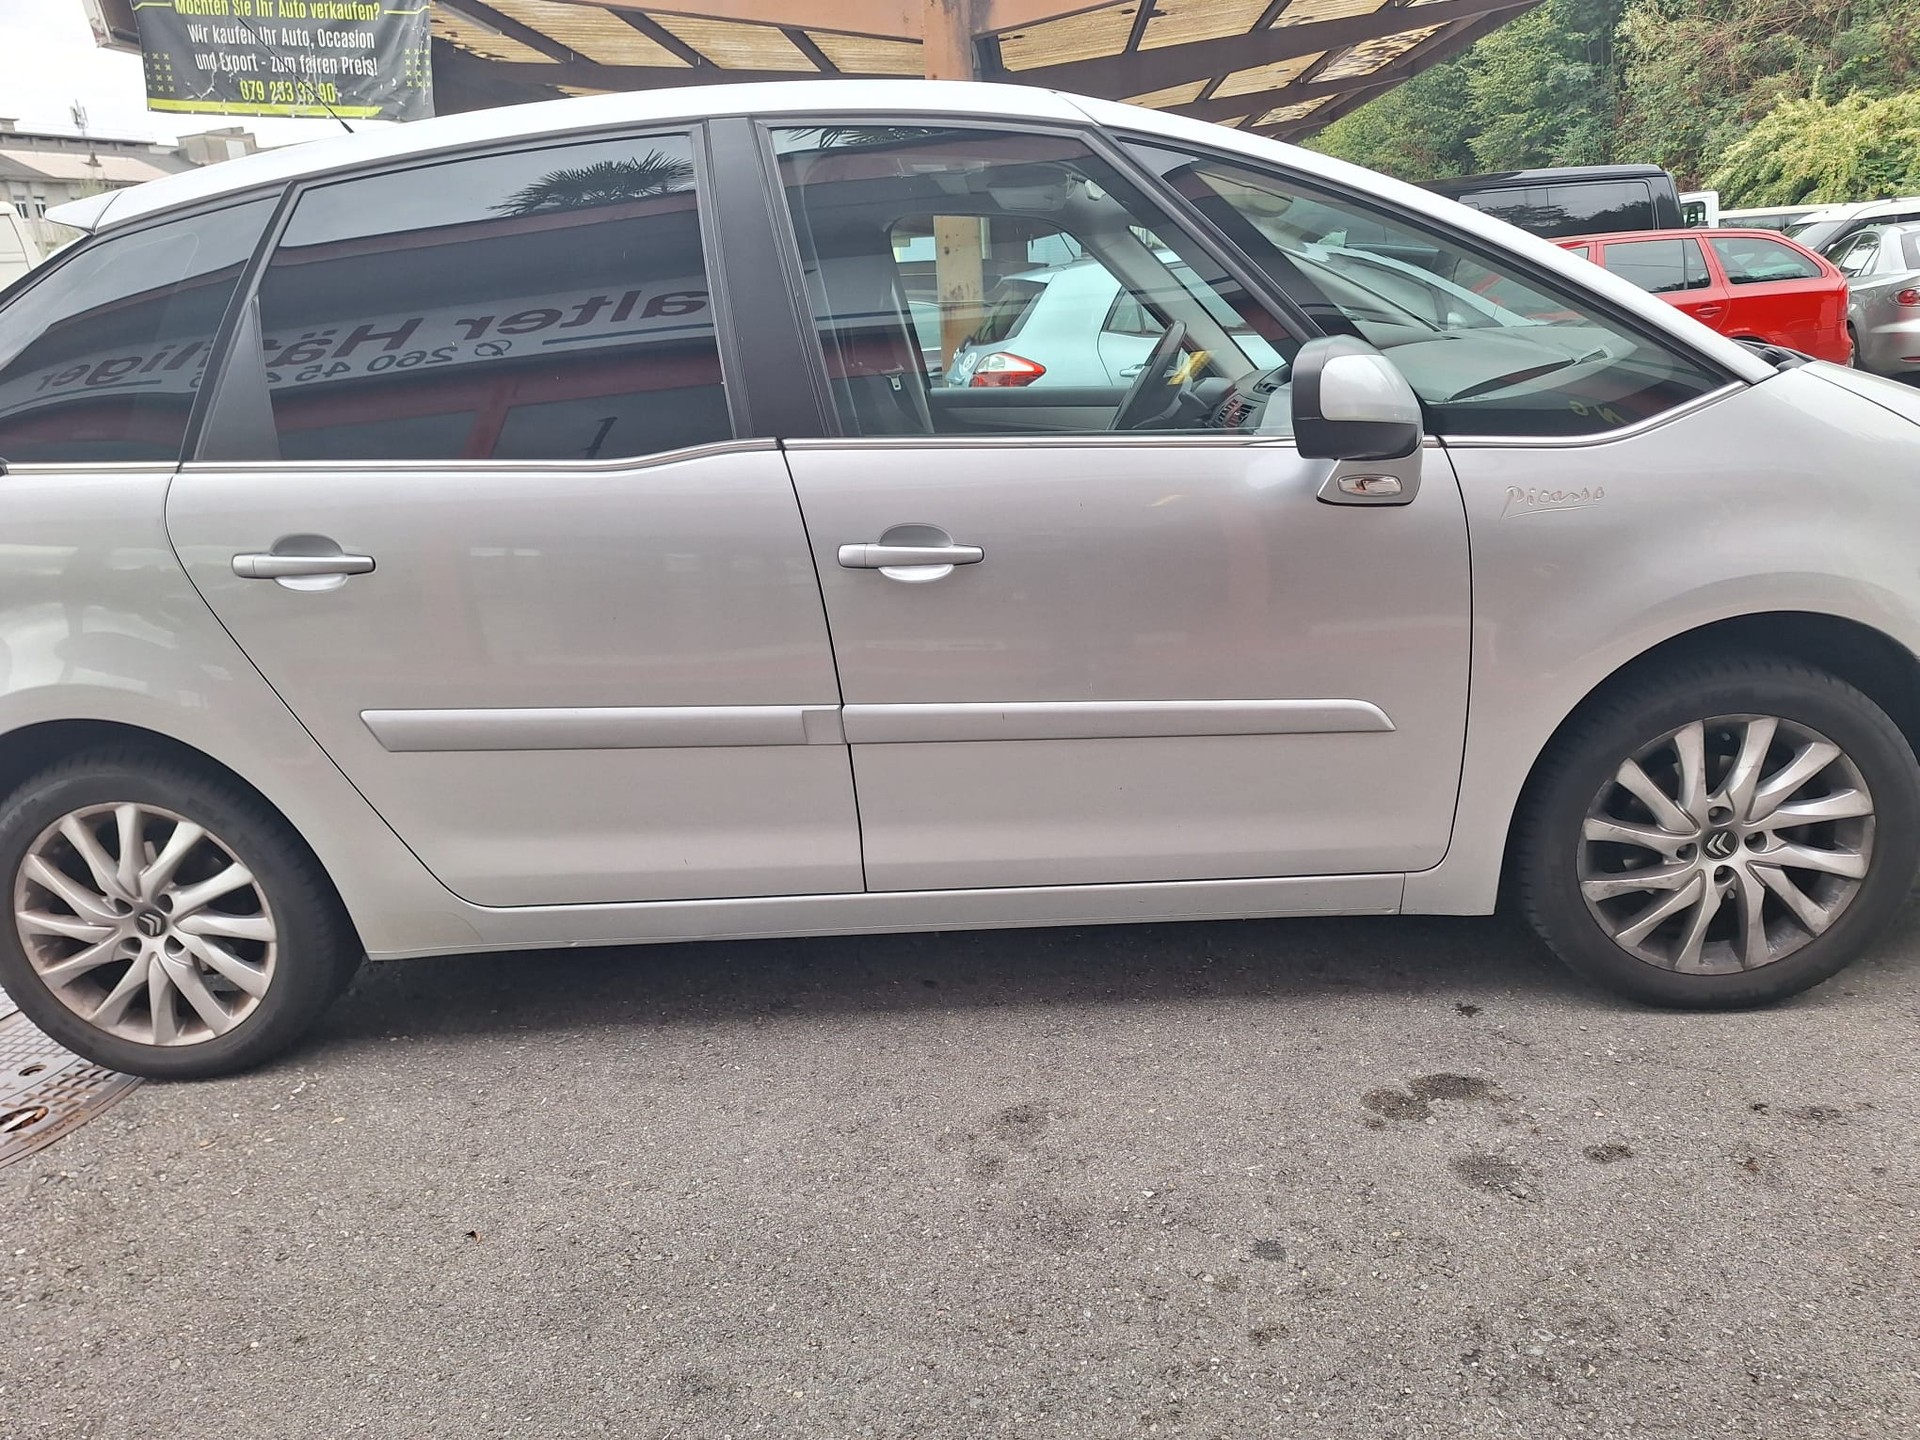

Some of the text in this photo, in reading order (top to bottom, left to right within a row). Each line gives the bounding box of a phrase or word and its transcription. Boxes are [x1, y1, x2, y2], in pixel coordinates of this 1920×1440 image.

[232, 0, 252, 17] Sie
[256, 0, 273, 17] Ihr
[278, 0, 306, 18] Auto
[309, 1, 380, 20] verkaufen?
[187, 23, 375, 49] Wir kaufen Ihr Auto, Occasion
[195, 52, 217, 71] und
[219, 52, 259, 73] Export
[270, 56, 296, 73] zum
[300, 55, 338, 75] fairen
[341, 56, 378, 77] Preis!
[240, 80, 265, 101] 079
[318, 83, 336, 104] 90
[1500, 485, 1605, 521] Picasso
